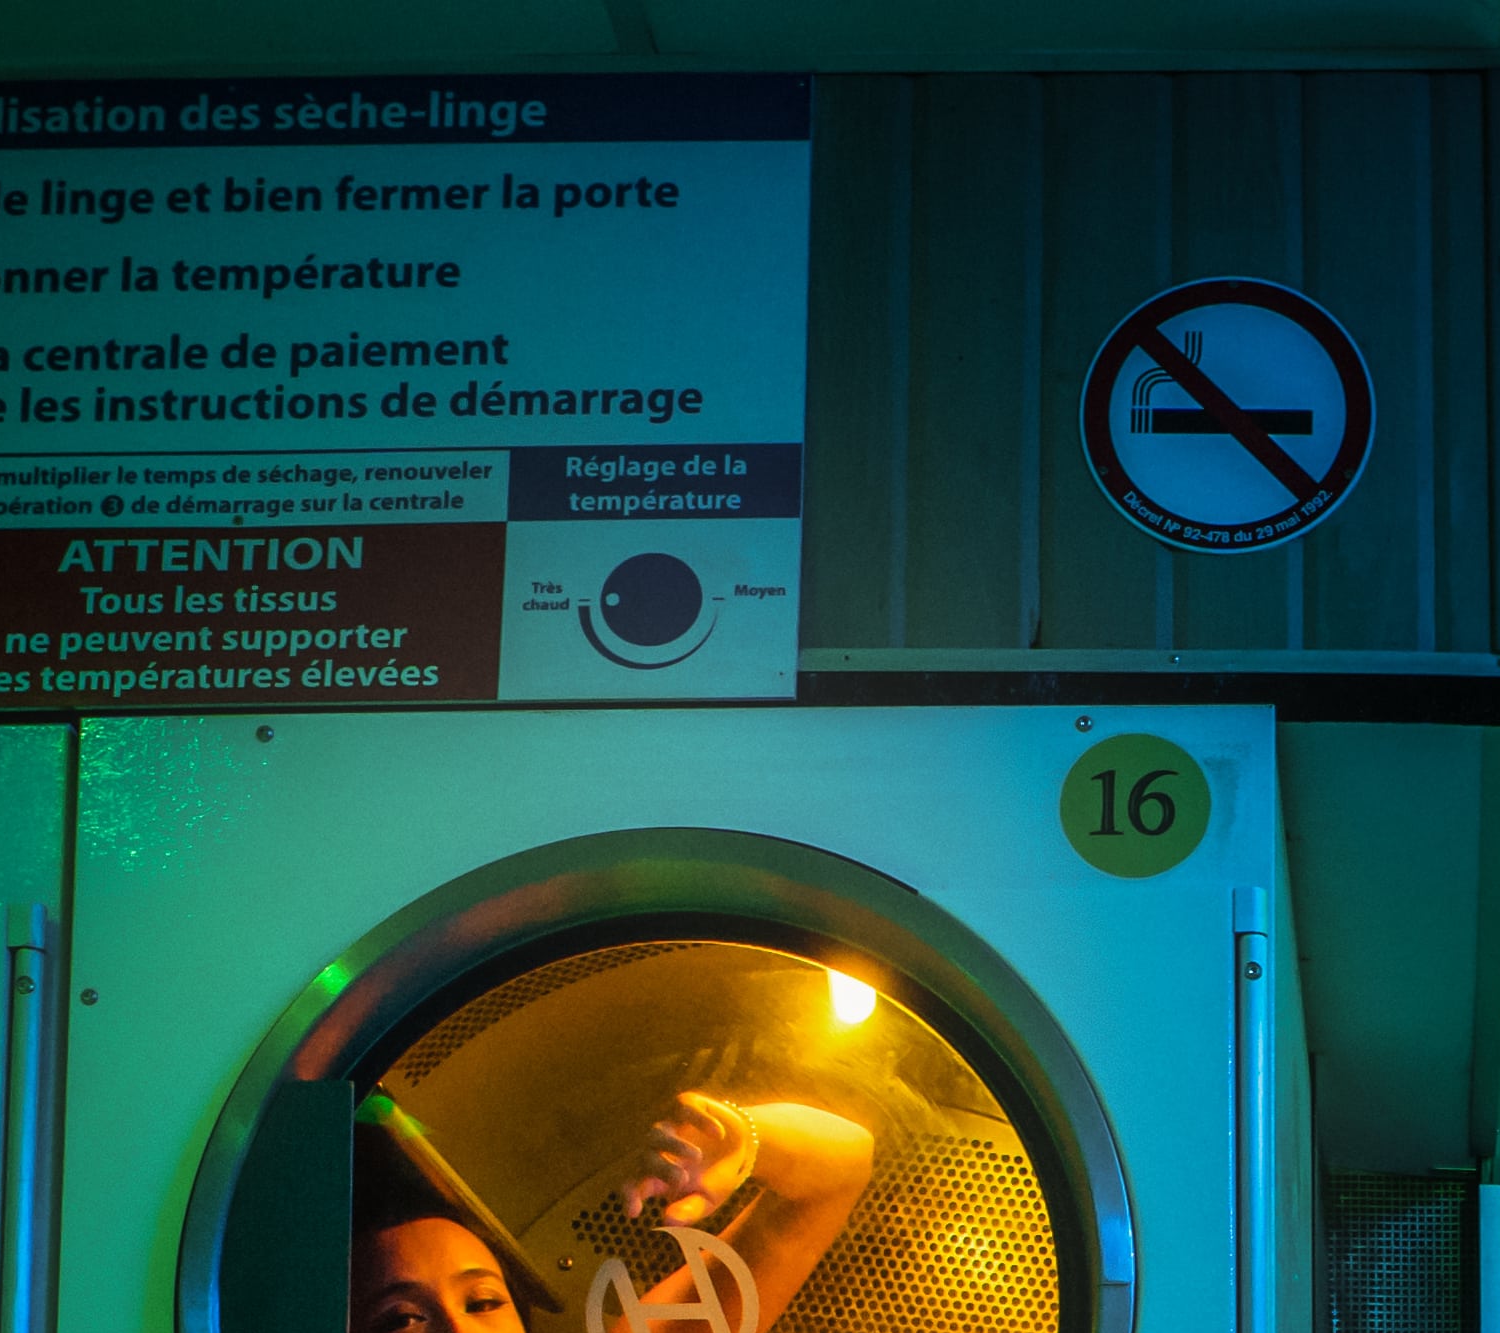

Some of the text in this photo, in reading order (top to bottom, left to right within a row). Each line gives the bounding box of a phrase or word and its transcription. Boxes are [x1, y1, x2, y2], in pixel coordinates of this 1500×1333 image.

[178, 93, 261, 132] des
[273, 90, 547, 137] sèche-linge
[40, 178, 154, 224] linge
[166, 182, 210, 214] et
[223, 176, 321, 212] bien
[335, 174, 490, 211] fermer
[502, 173, 539, 209] la
[553, 176, 679, 218] porte
[120, 255, 158, 292] la
[172, 253, 460, 299] température
[22, 333, 208, 372] centrale
[220, 332, 277, 369] de
[290, 331, 509, 378] paiement
[20, 386, 81, 423] les
[94, 383, 367, 422] instructions
[380, 382, 437, 418] de
[449, 381, 703, 424] démarrage
[116, 464, 138, 485] le
[143, 467, 216, 488] temps
[221, 464, 251, 484] de
[257, 462, 357, 487] séchage,
[364, 459, 493, 481] renouveler
[565, 453, 747, 483] Réglage de la
[568, 488, 741, 516] température
[1121, 489, 1163, 528] Décret
[1182, 523, 1230, 544] 92-478
[1234, 527, 1253, 542] du
[1255, 522, 1275, 541] 29
[56, 535, 363, 572] ATTENTION
[79, 583, 337, 614] Tous les tissus
[522, 598, 570, 611] chaud
[531, 581, 563, 595] Très
[734, 584, 786, 600] Moyen
[4, 623, 408, 660] ne peuvent supporter
[40, 661, 292, 697] températures
[300, 657, 439, 688] élevées
[1089, 769, 1180, 837] 16
